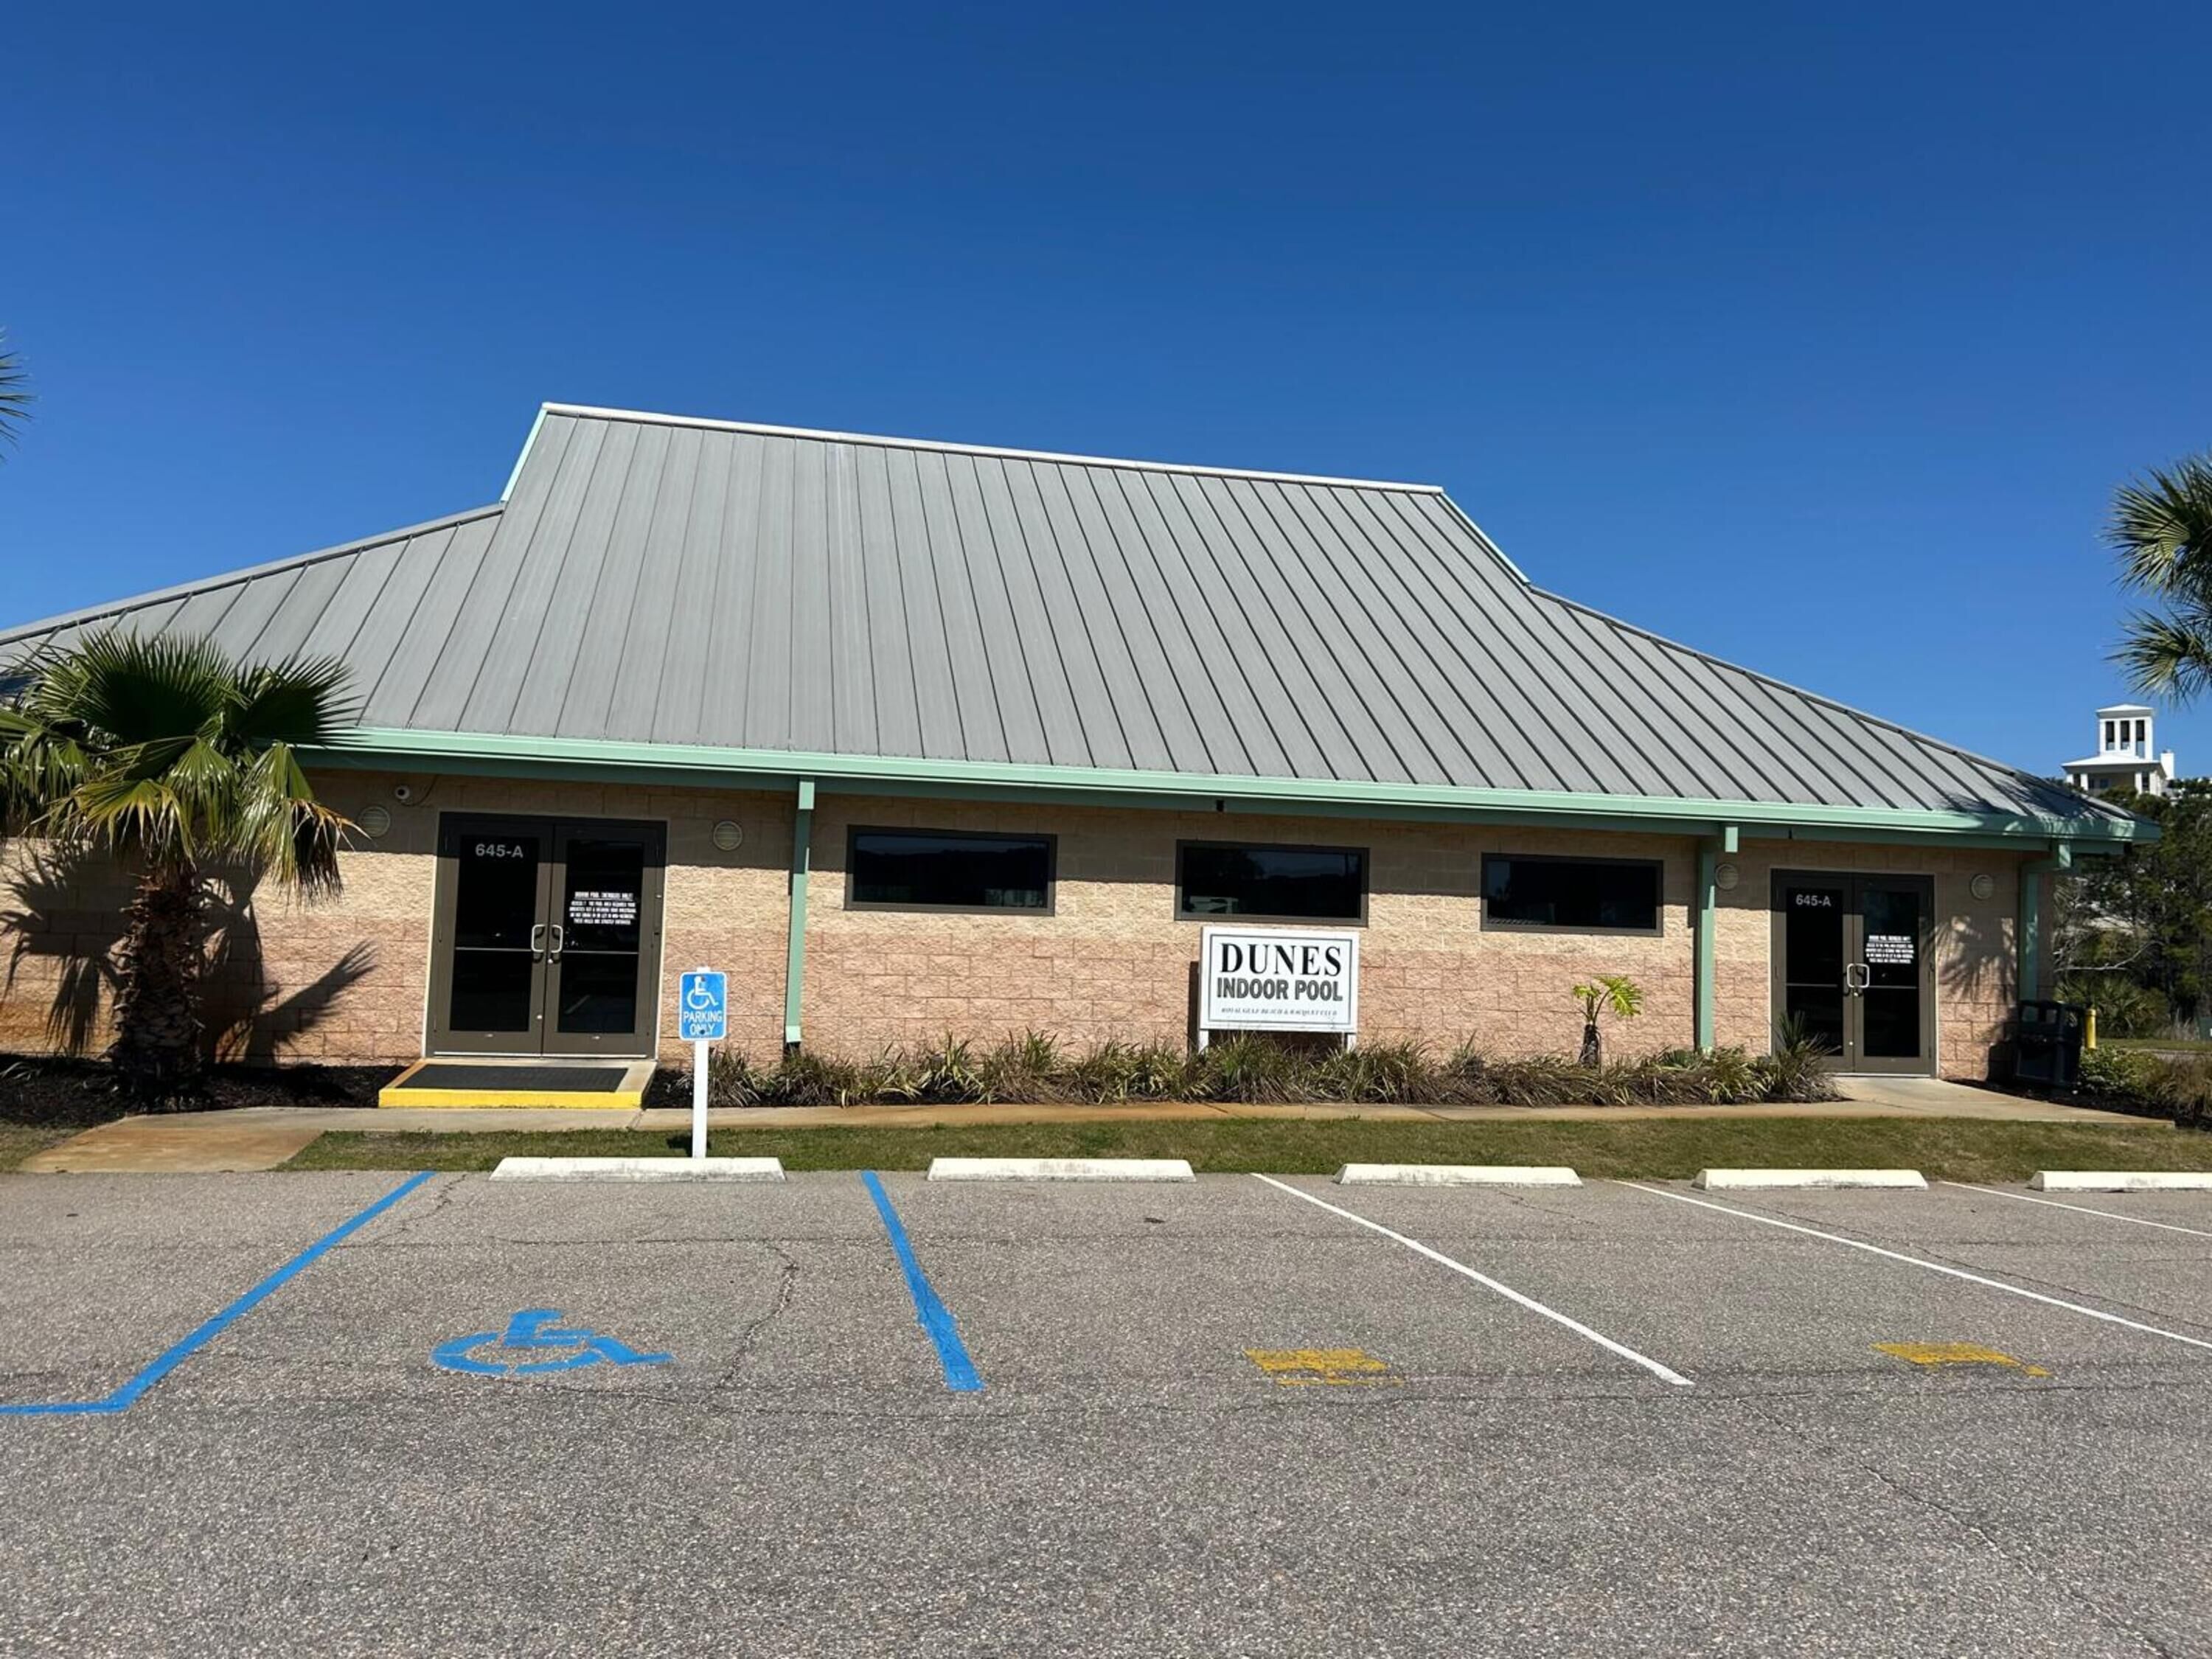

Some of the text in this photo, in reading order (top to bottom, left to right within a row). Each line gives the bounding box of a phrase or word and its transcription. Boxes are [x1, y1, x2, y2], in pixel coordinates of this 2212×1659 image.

[475, 843, 524, 858] 645-A
[1795, 894, 1832, 907] 645-A
[1219, 942, 1342, 977] DUNES
[1217, 977, 1343, 1001] INDOOR POOL
[684, 1011, 723, 1023] PARKING
[689, 1023, 715, 1035] ONLY
